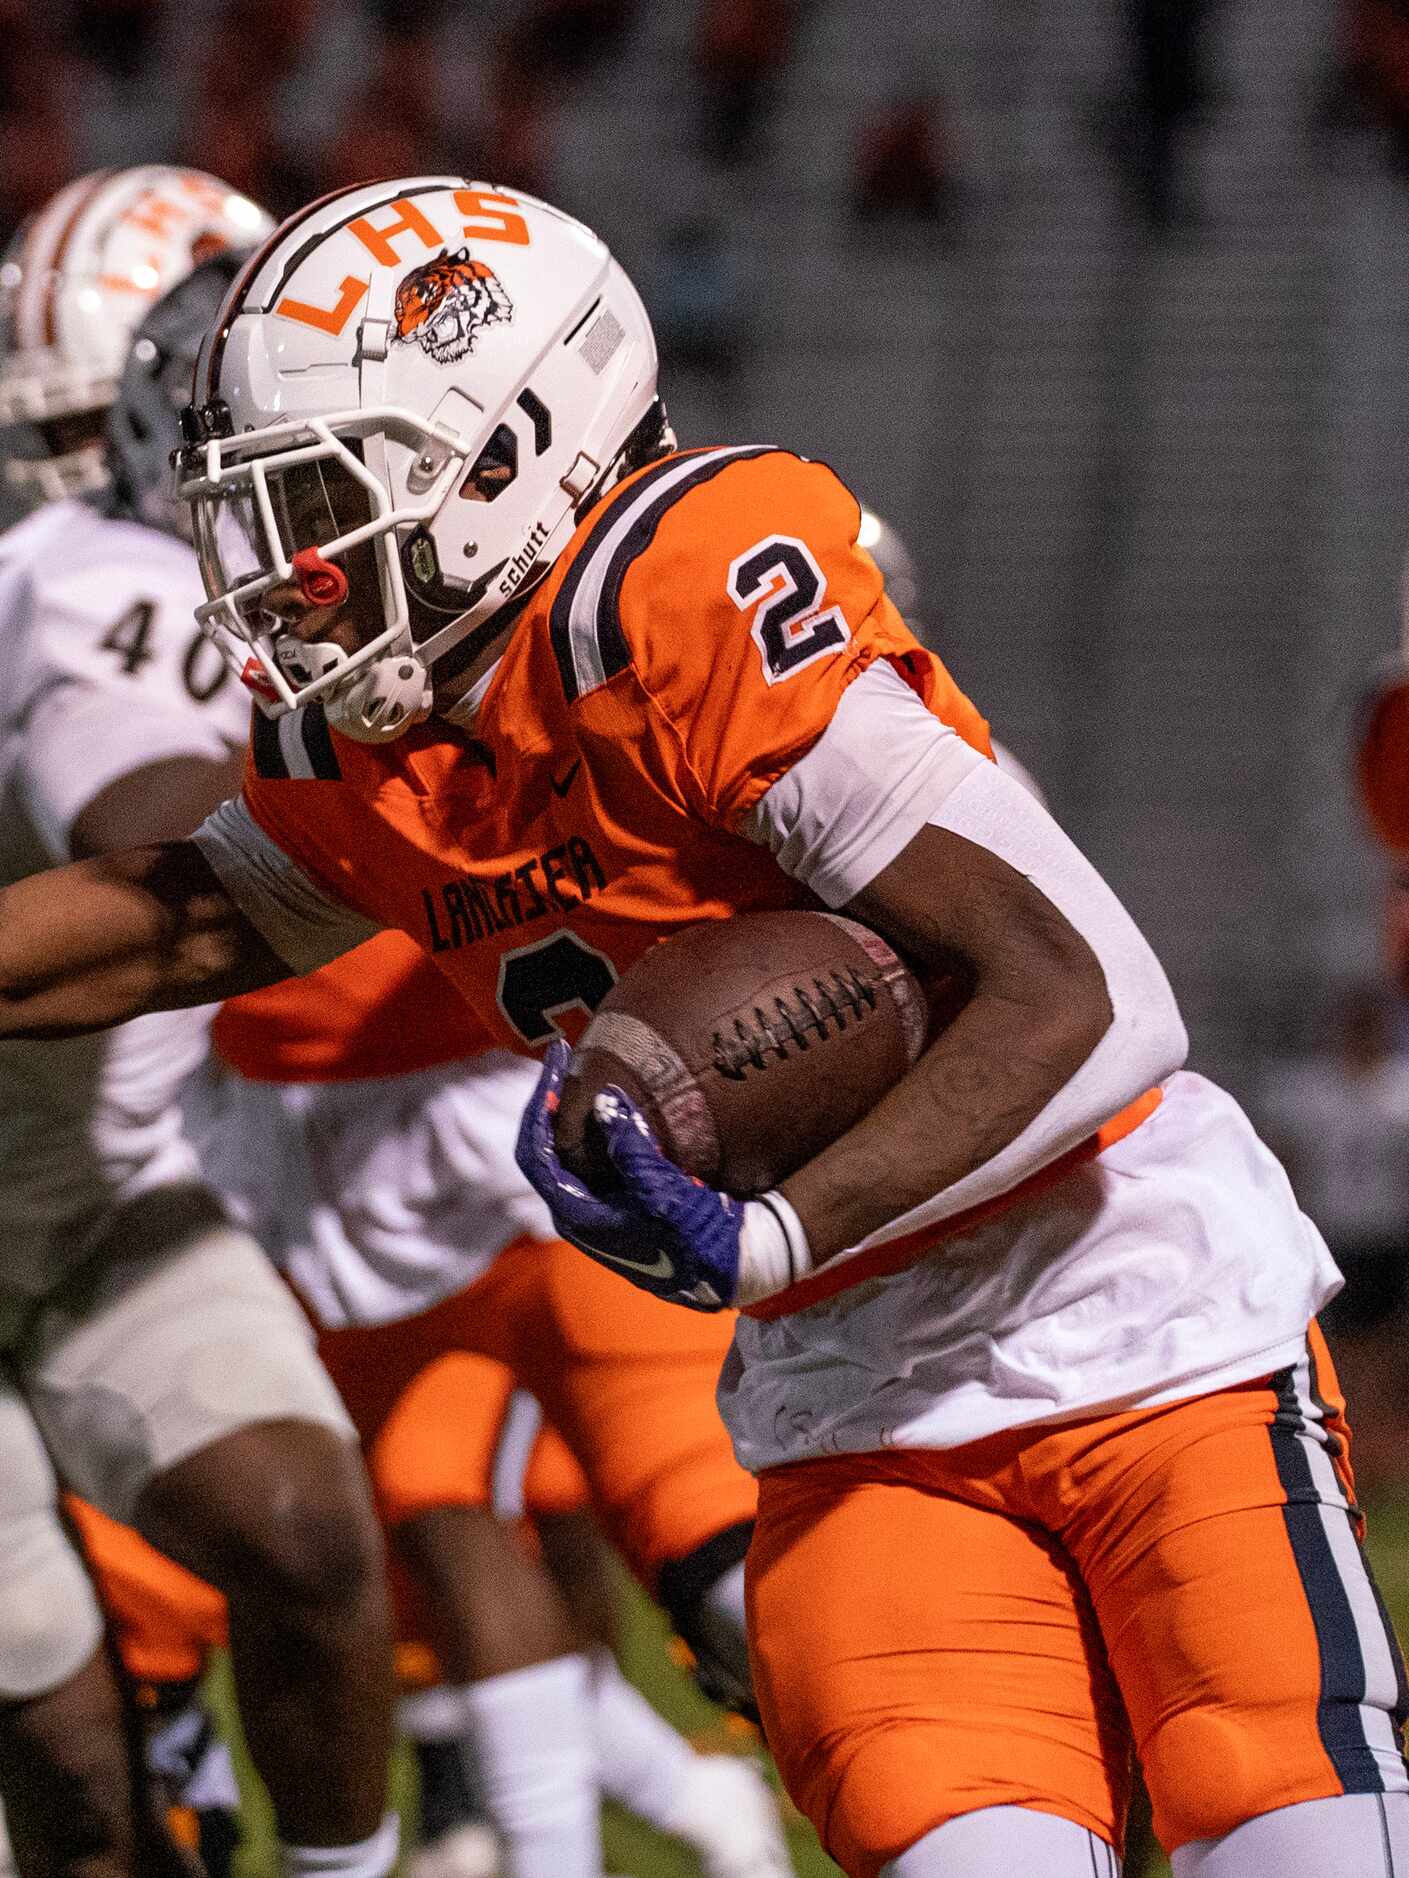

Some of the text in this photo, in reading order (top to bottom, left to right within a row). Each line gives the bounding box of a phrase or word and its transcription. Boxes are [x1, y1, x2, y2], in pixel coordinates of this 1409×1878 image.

[276, 191, 531, 337] LHS
[499, 521, 551, 598] schutt
[726, 534, 853, 687] 2
[100, 598, 228, 703] 40
